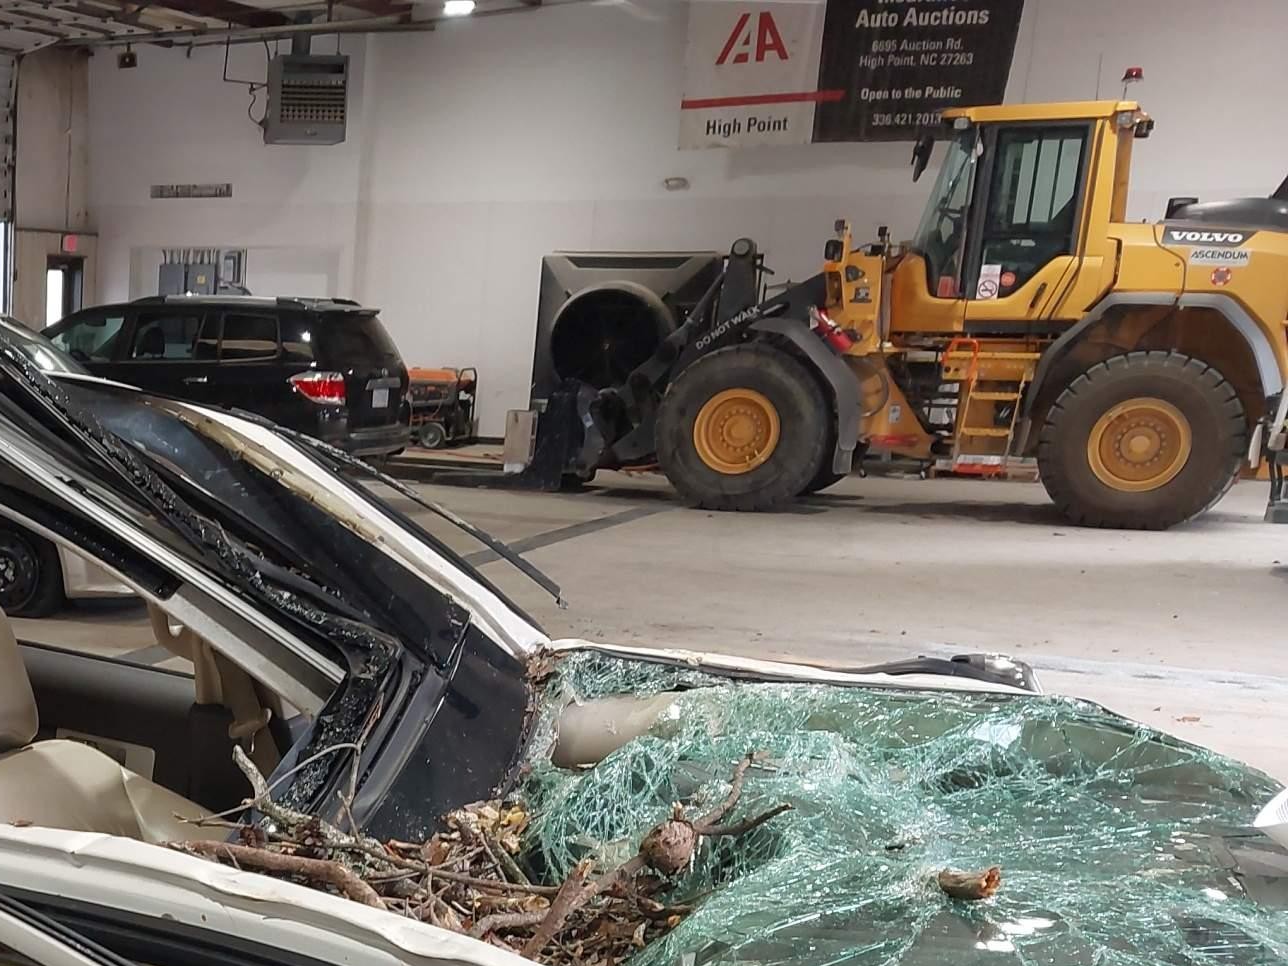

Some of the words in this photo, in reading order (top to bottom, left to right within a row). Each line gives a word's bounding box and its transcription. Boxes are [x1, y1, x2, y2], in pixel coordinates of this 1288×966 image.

[856, 9, 898, 28] Auto
[903, 6, 990, 27] Auctions
[900, 39, 943, 51] Auction
[859, 55, 885, 69] High
[920, 53, 938, 66] NC
[939, 52, 974, 65] 27263
[860, 88, 889, 103] Open
[892, 88, 902, 99] to
[904, 87, 922, 99] the
[925, 86, 962, 98] Public
[706, 118, 741, 138] High
[747, 115, 788, 133] Point
[1170, 231, 1243, 243] VOLVO
[1191, 250, 1249, 260] ASCENDUM
[695, 335, 711, 350] DO
[710, 320, 731, 341] NOT
[731, 304, 761, 326] WALK
